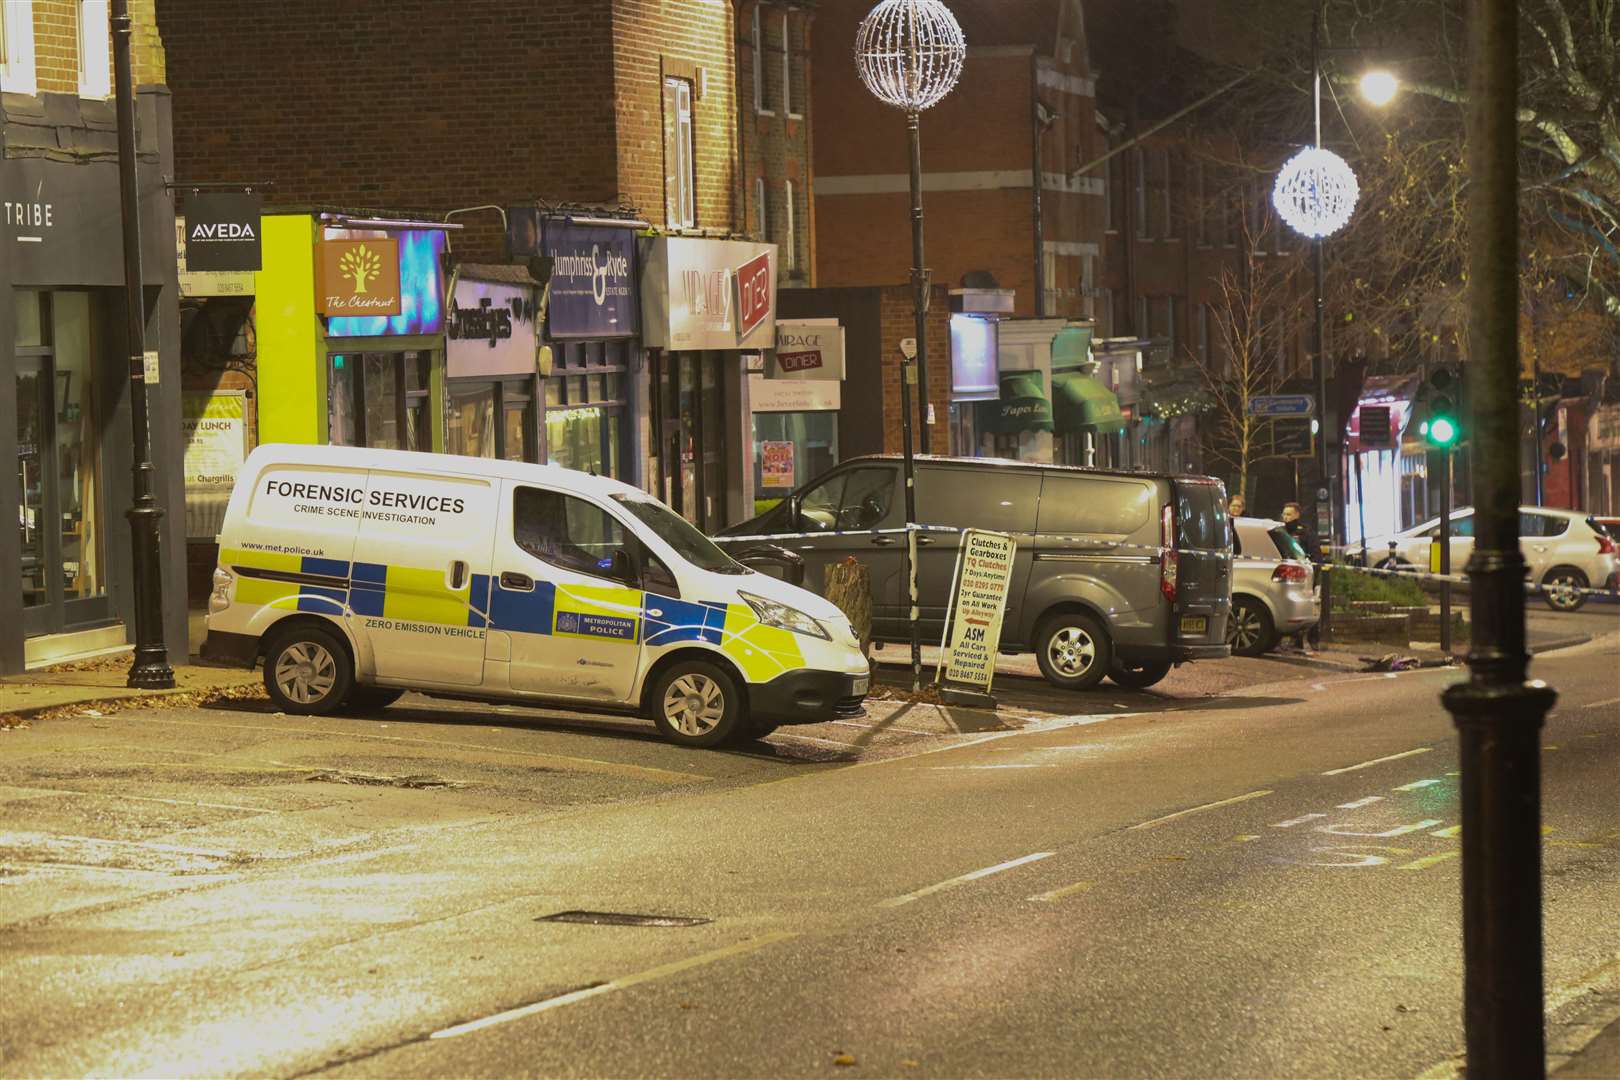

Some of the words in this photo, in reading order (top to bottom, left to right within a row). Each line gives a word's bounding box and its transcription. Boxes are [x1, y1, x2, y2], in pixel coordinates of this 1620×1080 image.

[4, 202, 53, 226] TRIBE
[191, 223, 255, 238] AVEDA
[592, 243, 607, 306] &
[607, 250, 627, 283] Ryde
[326, 296, 346, 308] The
[348, 295, 395, 307] Chestnut
[201, 422, 231, 431] LUNCH
[198, 474, 234, 484] Chargrills
[266, 480, 363, 504] FORENSIC
[368, 490, 465, 514] SERVICES
[294, 504, 325, 515] CRIME
[327, 507, 360, 518] SCENE
[361, 510, 436, 526] INVESTIGATION
[241, 541, 325, 556] www.met.police.uk
[971, 537, 1001, 549] Clutches
[1002, 543, 1008, 551] &
[970, 547, 1007, 560] Gearboxes
[978, 559, 1007, 570] Clutches
[969, 569, 982, 578] Days
[972, 590, 1002, 602] Guarantee
[981, 602, 997, 610] Work
[365, 618, 392, 629] ZERO
[395, 622, 441, 635] EMISSION
[444, 626, 485, 639] VEHICLE
[583, 617, 632, 628] METROPOLITAN
[590, 626, 625, 636] POLICE
[964, 627, 985, 642] ASM
[960, 641, 970, 649] All
[971, 643, 986, 651] Cars
[953, 649, 982, 660] Serviced
[954, 658, 985, 670] Repaired
